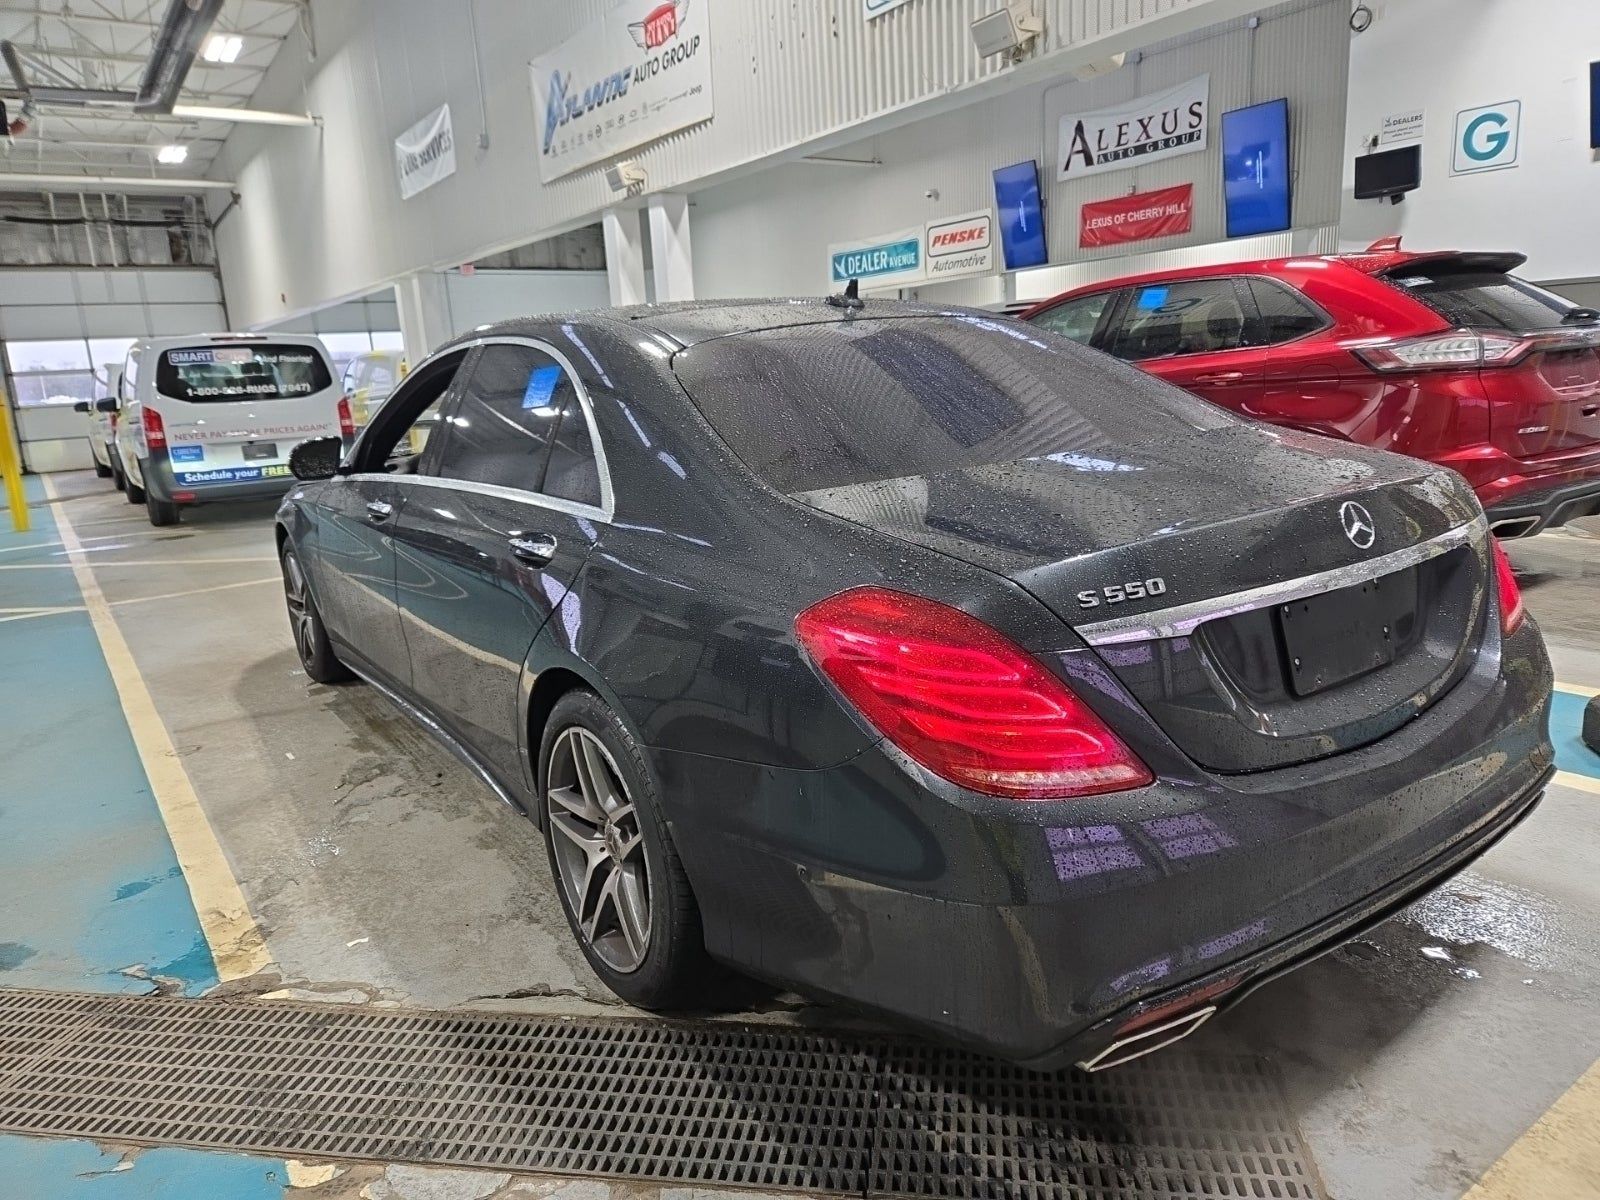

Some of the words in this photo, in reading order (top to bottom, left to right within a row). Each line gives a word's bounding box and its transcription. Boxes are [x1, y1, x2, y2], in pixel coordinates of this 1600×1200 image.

[633, 58, 660, 86] AUTO
[662, 34, 701, 71] GROUP
[1063, 101, 1203, 172] ALEXUS
[1099, 147, 1135, 164] AUTO
[1147, 131, 1202, 153] GROUP
[1086, 215, 1113, 229] LEXUS
[1114, 213, 1126, 225] OF
[1127, 207, 1165, 223] CHERRY
[1165, 203, 1187, 216] HILL
[931, 226, 986, 248] PENSKE
[848, 251, 888, 275] DEALER
[889, 253, 916, 268] AVENUE
[932, 253, 987, 273] Automotive
[171, 351, 213, 363] SMART
[174, 431, 207, 441] NEVER
[264, 425, 296, 434] PRICES
[184, 469, 233, 482] Schedule
[235, 469, 260, 480] your
[1077, 590, 1100, 608] S
[1103, 577, 1167, 604] 550
